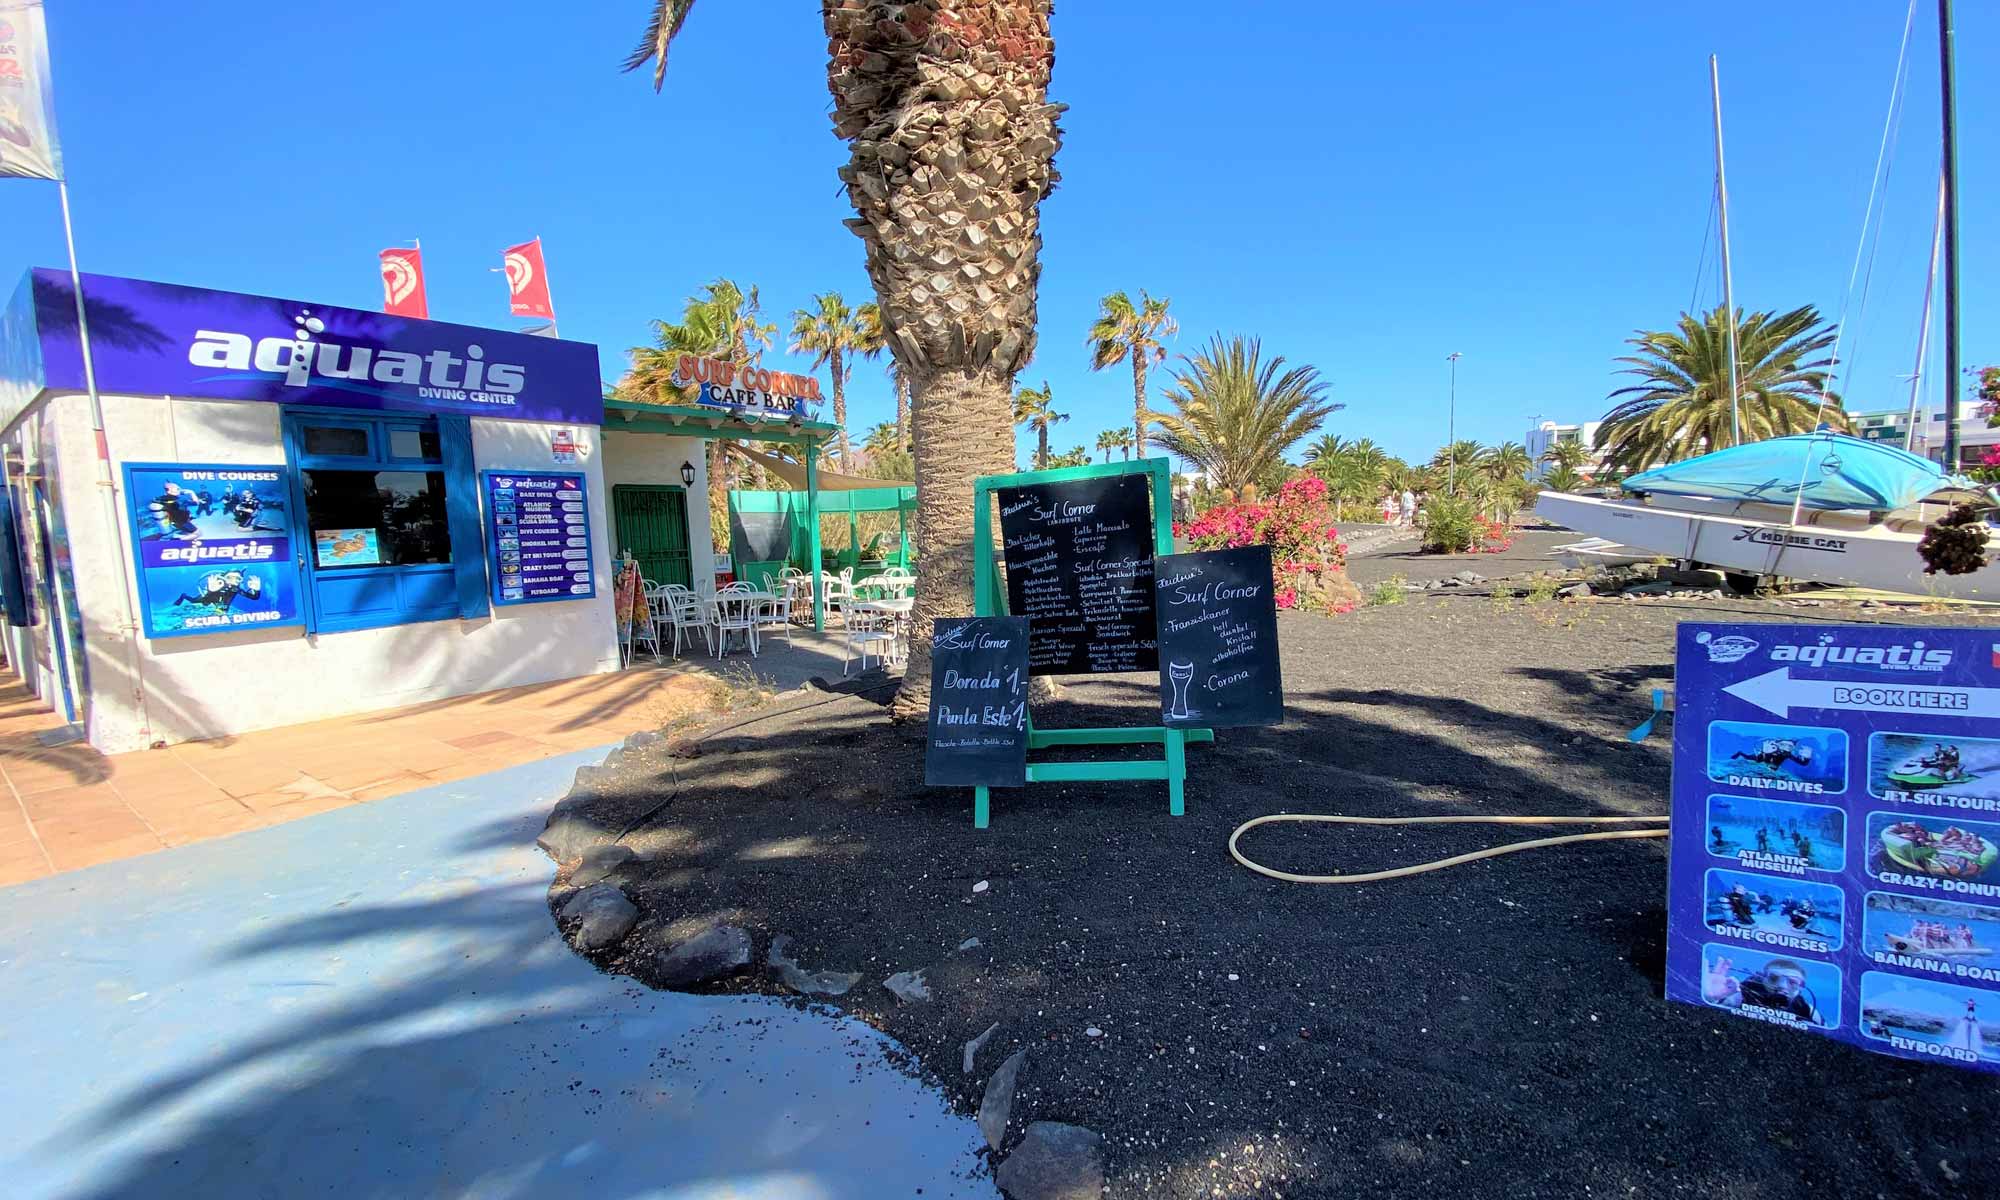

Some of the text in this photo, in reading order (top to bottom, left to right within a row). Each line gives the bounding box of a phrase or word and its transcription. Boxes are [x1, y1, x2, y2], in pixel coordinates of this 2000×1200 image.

[188, 327, 526, 394] aquatis
[679, 355, 822, 401] SURF CORNER
[418, 387, 516, 406] DIVING CENTER
[710, 387, 796, 411] CAFE BAR
[183, 472, 278, 482] DIVE COURSES
[516, 479, 557, 489] aquatis
[1029, 500, 1096, 521] Surf Corner
[161, 541, 273, 563] aquatis
[1814, 537, 1849, 550] CAT
[1032, 562, 1057, 575] Kuchen
[1073, 560, 1095, 573] Surf
[1096, 559, 1122, 570] Corner
[530, 588, 559, 596] FLYBOARD
[1081, 587, 1117, 599] Currywurst
[1169, 581, 1261, 605] Surf Corner
[185, 611, 281, 628] SCUBA DIVING
[1168, 607, 1230, 633] Franziskaner
[1212, 620, 1228, 633] hell
[942, 632, 980, 652] Surf
[979, 632, 1011, 649] Corner
[1095, 630, 1132, 638] Sandwich
[1769, 640, 1953, 668] aquatis
[1879, 663, 1910, 671] DIVING
[943, 669, 1001, 690] Dorada
[1207, 670, 1249, 691] Corona
[1834, 687, 1969, 710] BOOK HERE
[937, 705, 978, 726] Punta
[982, 705, 1013, 727] Este
[1729, 775, 1824, 795] DAILY DIVES
[1882, 790, 1910, 803] JET
[1913, 793, 1943, 806] SKI
[1737, 850, 1809, 867] ATLANTIC
[1741, 859, 1806, 875] MUSEUM
[1878, 871, 1938, 890] CRAZY
[1715, 924, 1828, 953] DIVE COURSES
[1874, 951, 1952, 975] BANANA
[1741, 1003, 1797, 1022] DISCOVER
[1890, 1035, 1978, 1063] FLYBOARD
